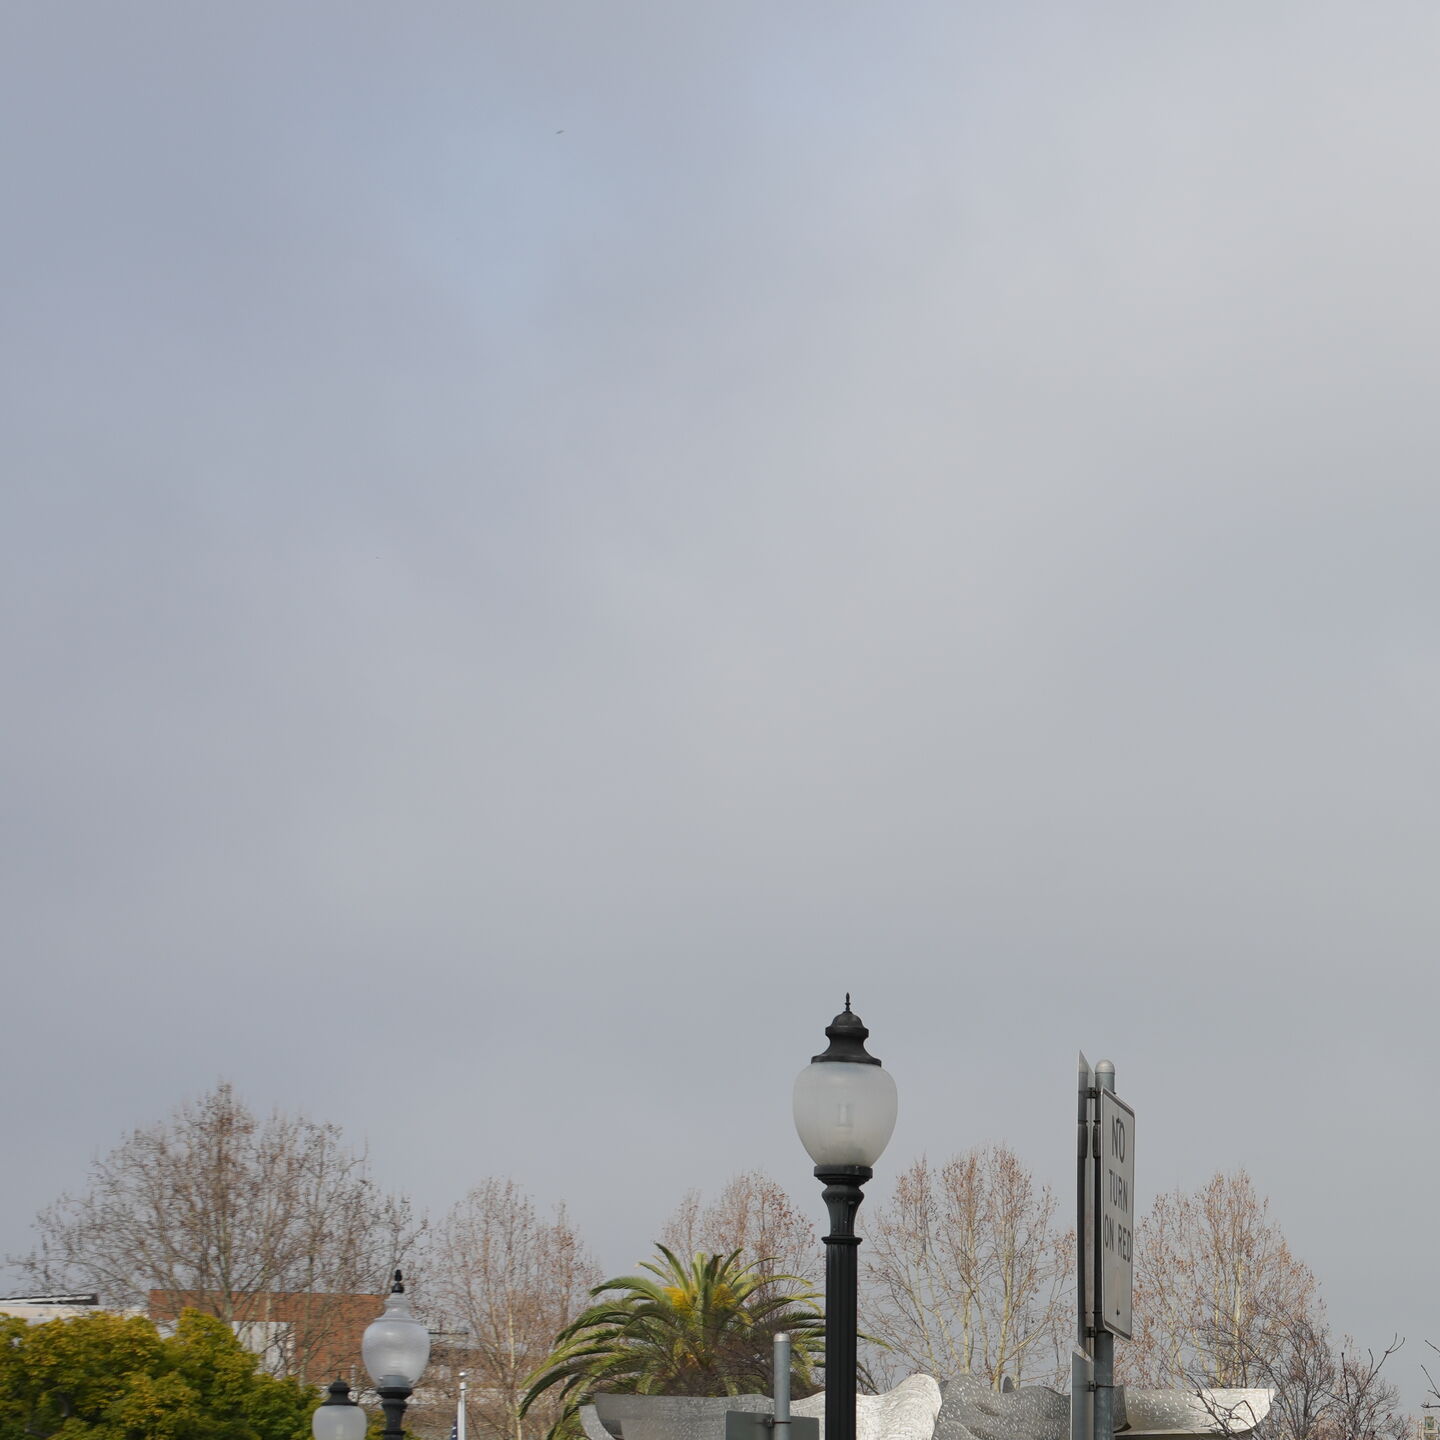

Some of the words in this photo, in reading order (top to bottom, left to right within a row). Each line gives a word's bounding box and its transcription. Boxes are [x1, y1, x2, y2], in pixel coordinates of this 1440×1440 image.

[1111, 1115, 1126, 1163] NO
[1109, 1169, 1128, 1214] TURN
[1104, 1213, 1115, 1252] ON
[1117, 1223, 1132, 1263] RED
